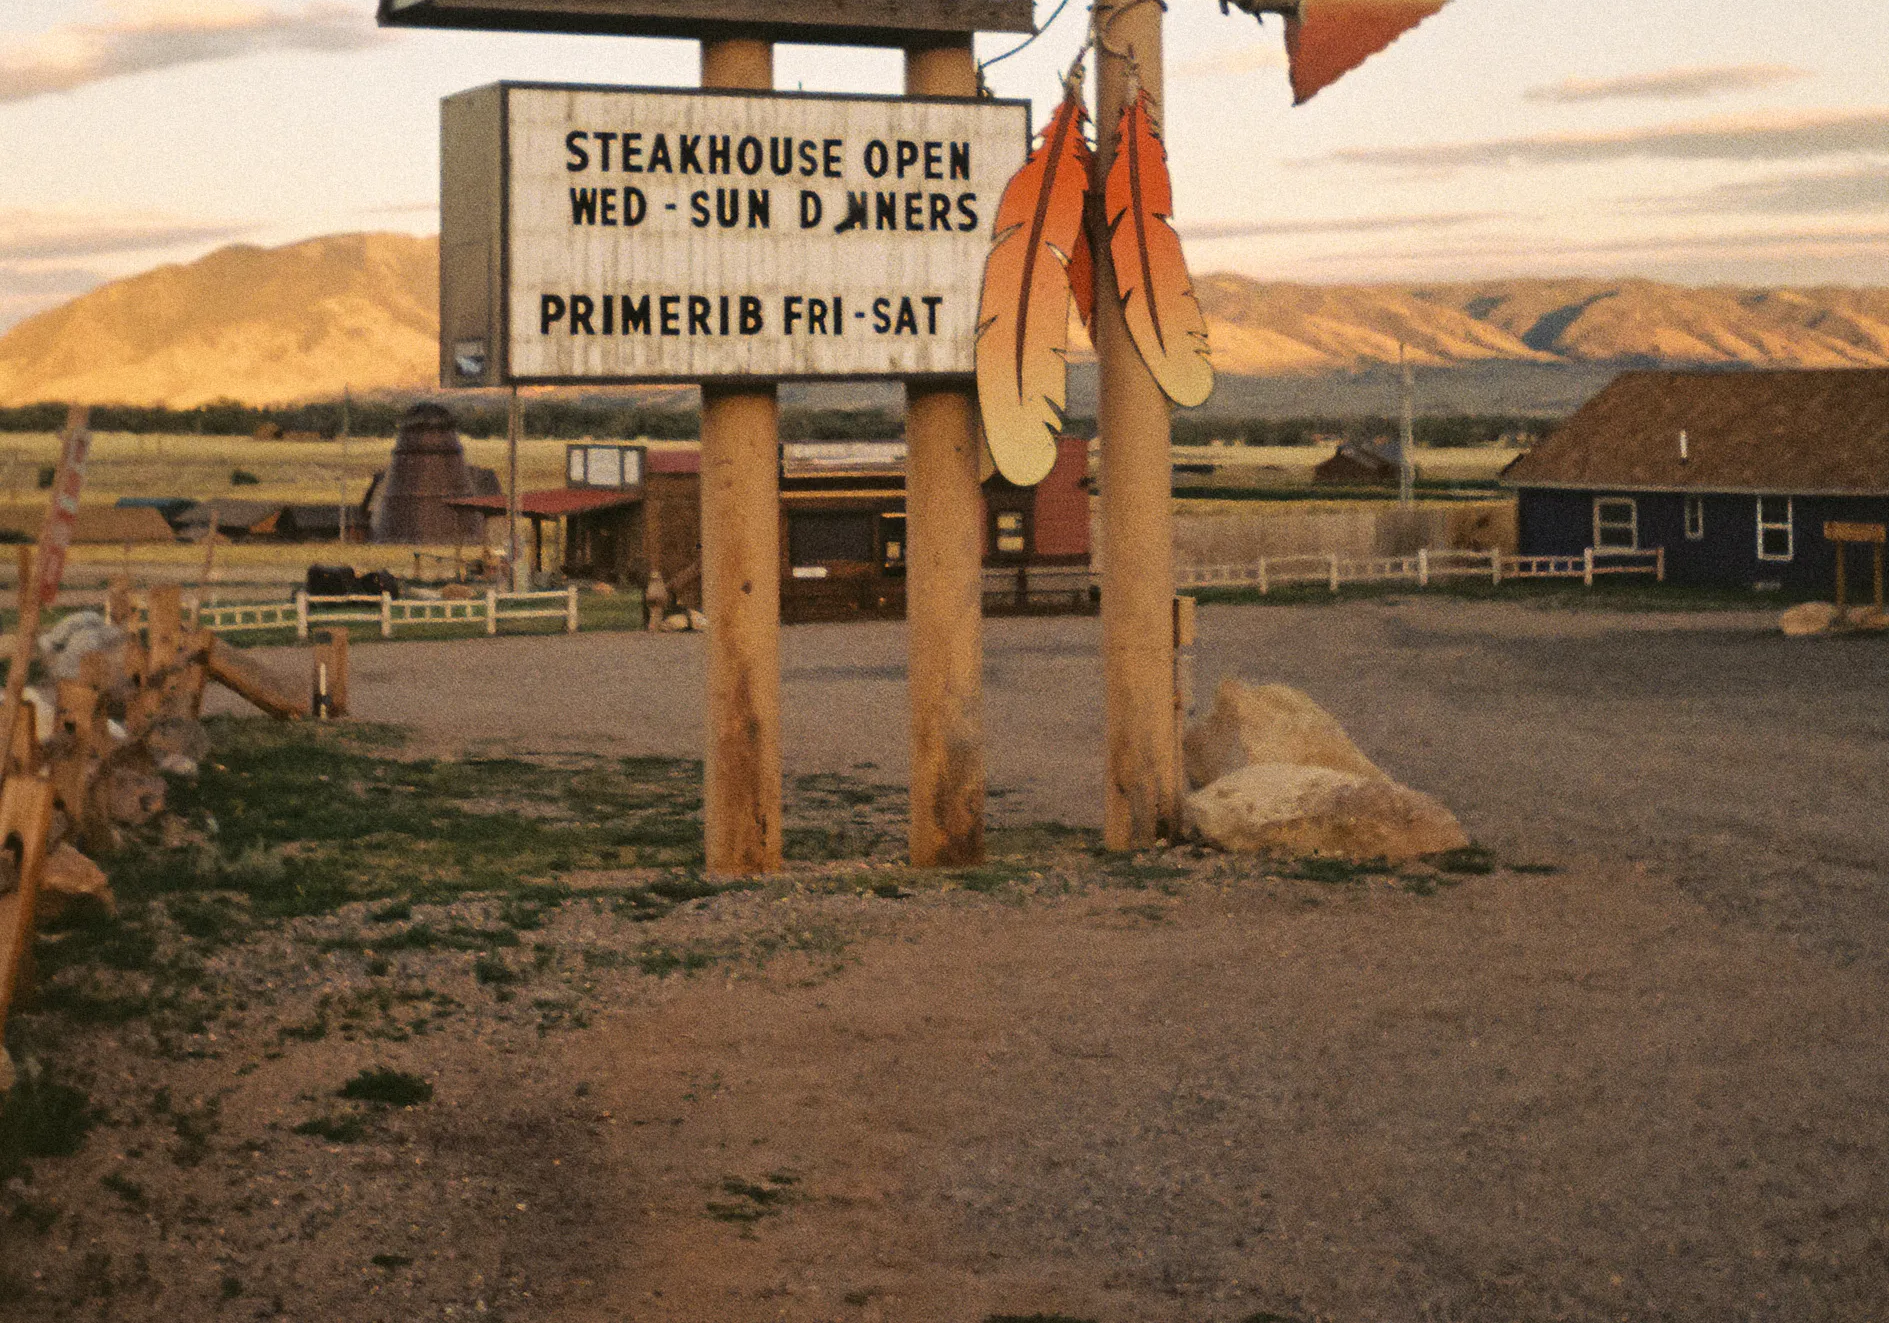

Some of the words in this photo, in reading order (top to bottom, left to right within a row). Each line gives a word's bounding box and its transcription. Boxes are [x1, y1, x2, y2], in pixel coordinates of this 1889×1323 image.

[565, 130, 843, 177] STEAKHOUSE
[864, 139, 972, 181] OPEN
[540, 294, 764, 336] PRIMERIB
